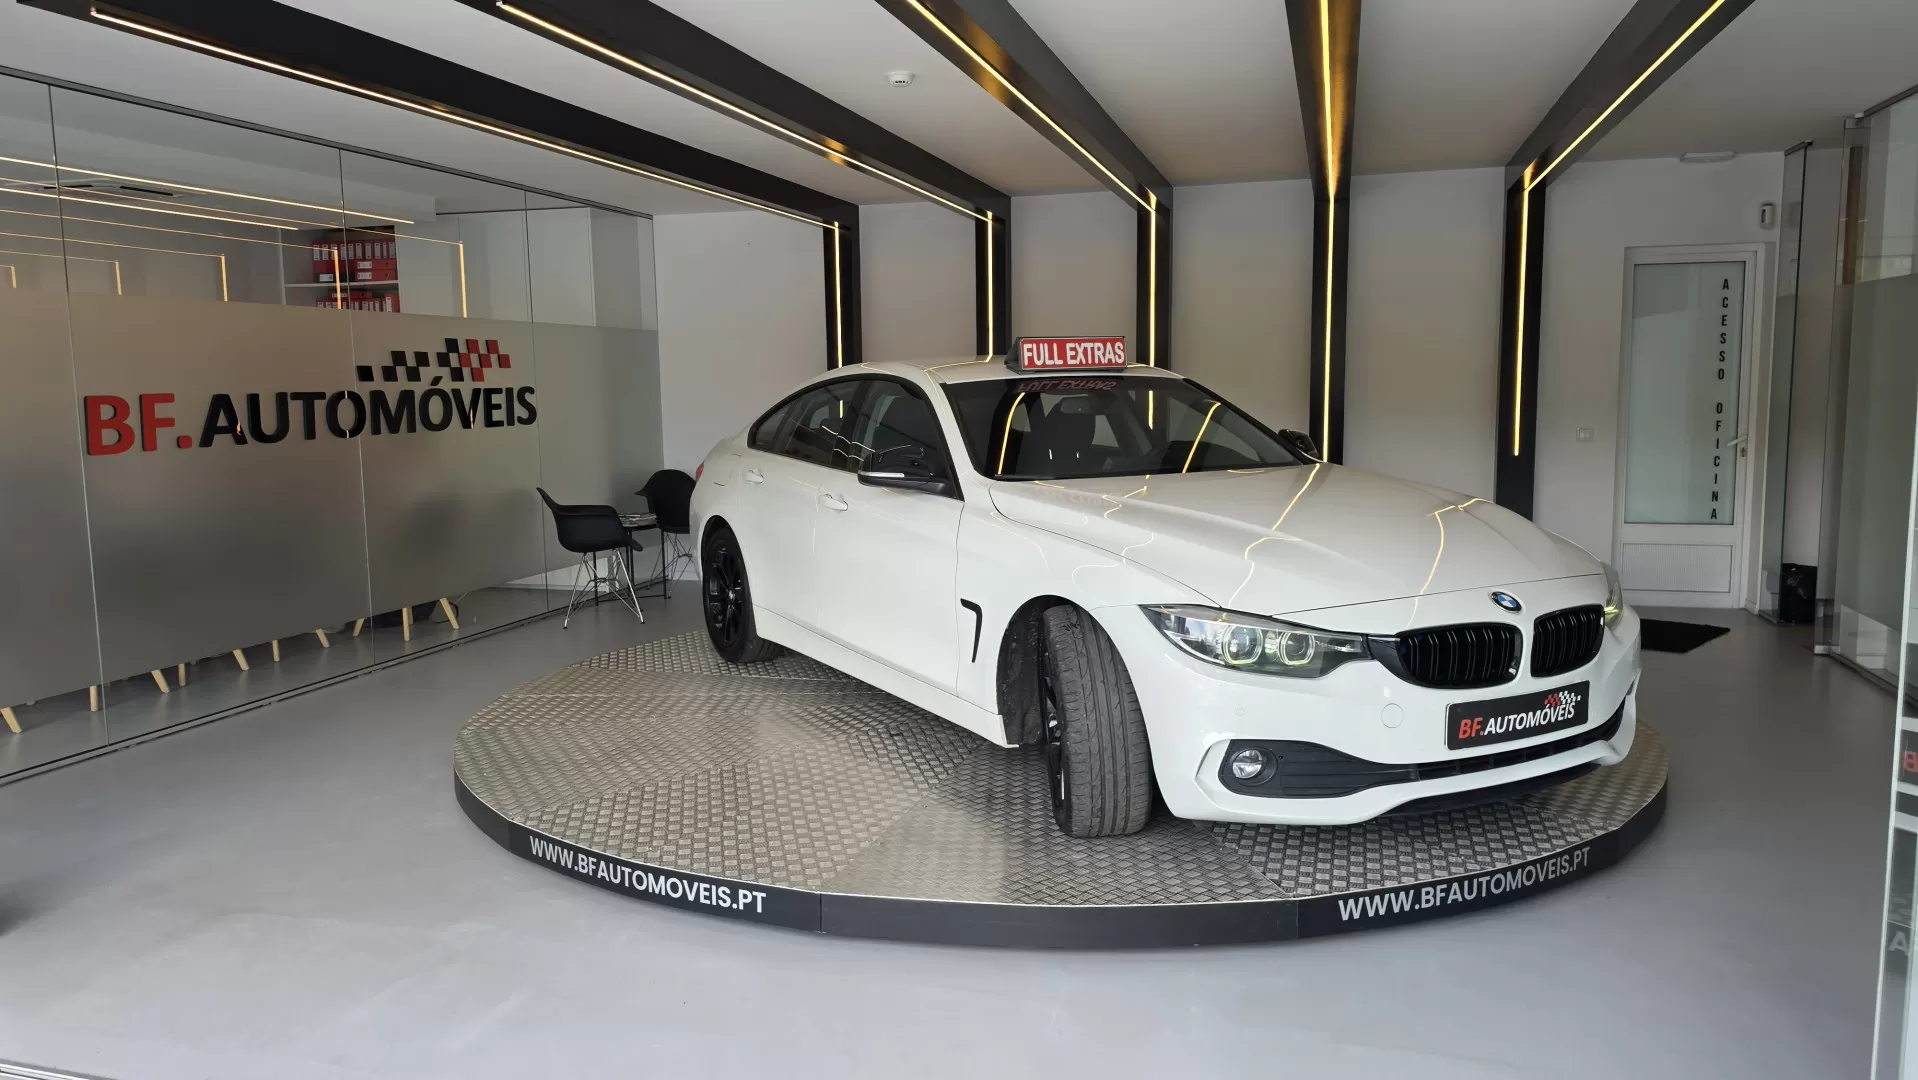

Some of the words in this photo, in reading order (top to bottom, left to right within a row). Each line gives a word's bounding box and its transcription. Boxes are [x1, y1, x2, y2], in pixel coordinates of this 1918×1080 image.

[1023, 342, 1064, 366] FULL
[1066, 341, 1125, 365] EXTRAS
[1717, 278, 1729, 381] ACESSO
[1710, 402, 1723, 520] OFICINA
[529, 835, 767, 913] WWW.BFAUTOMOVEIS.PT
[1337, 846, 1591, 922] WWW.BFAUTOMOVEIS.PT
